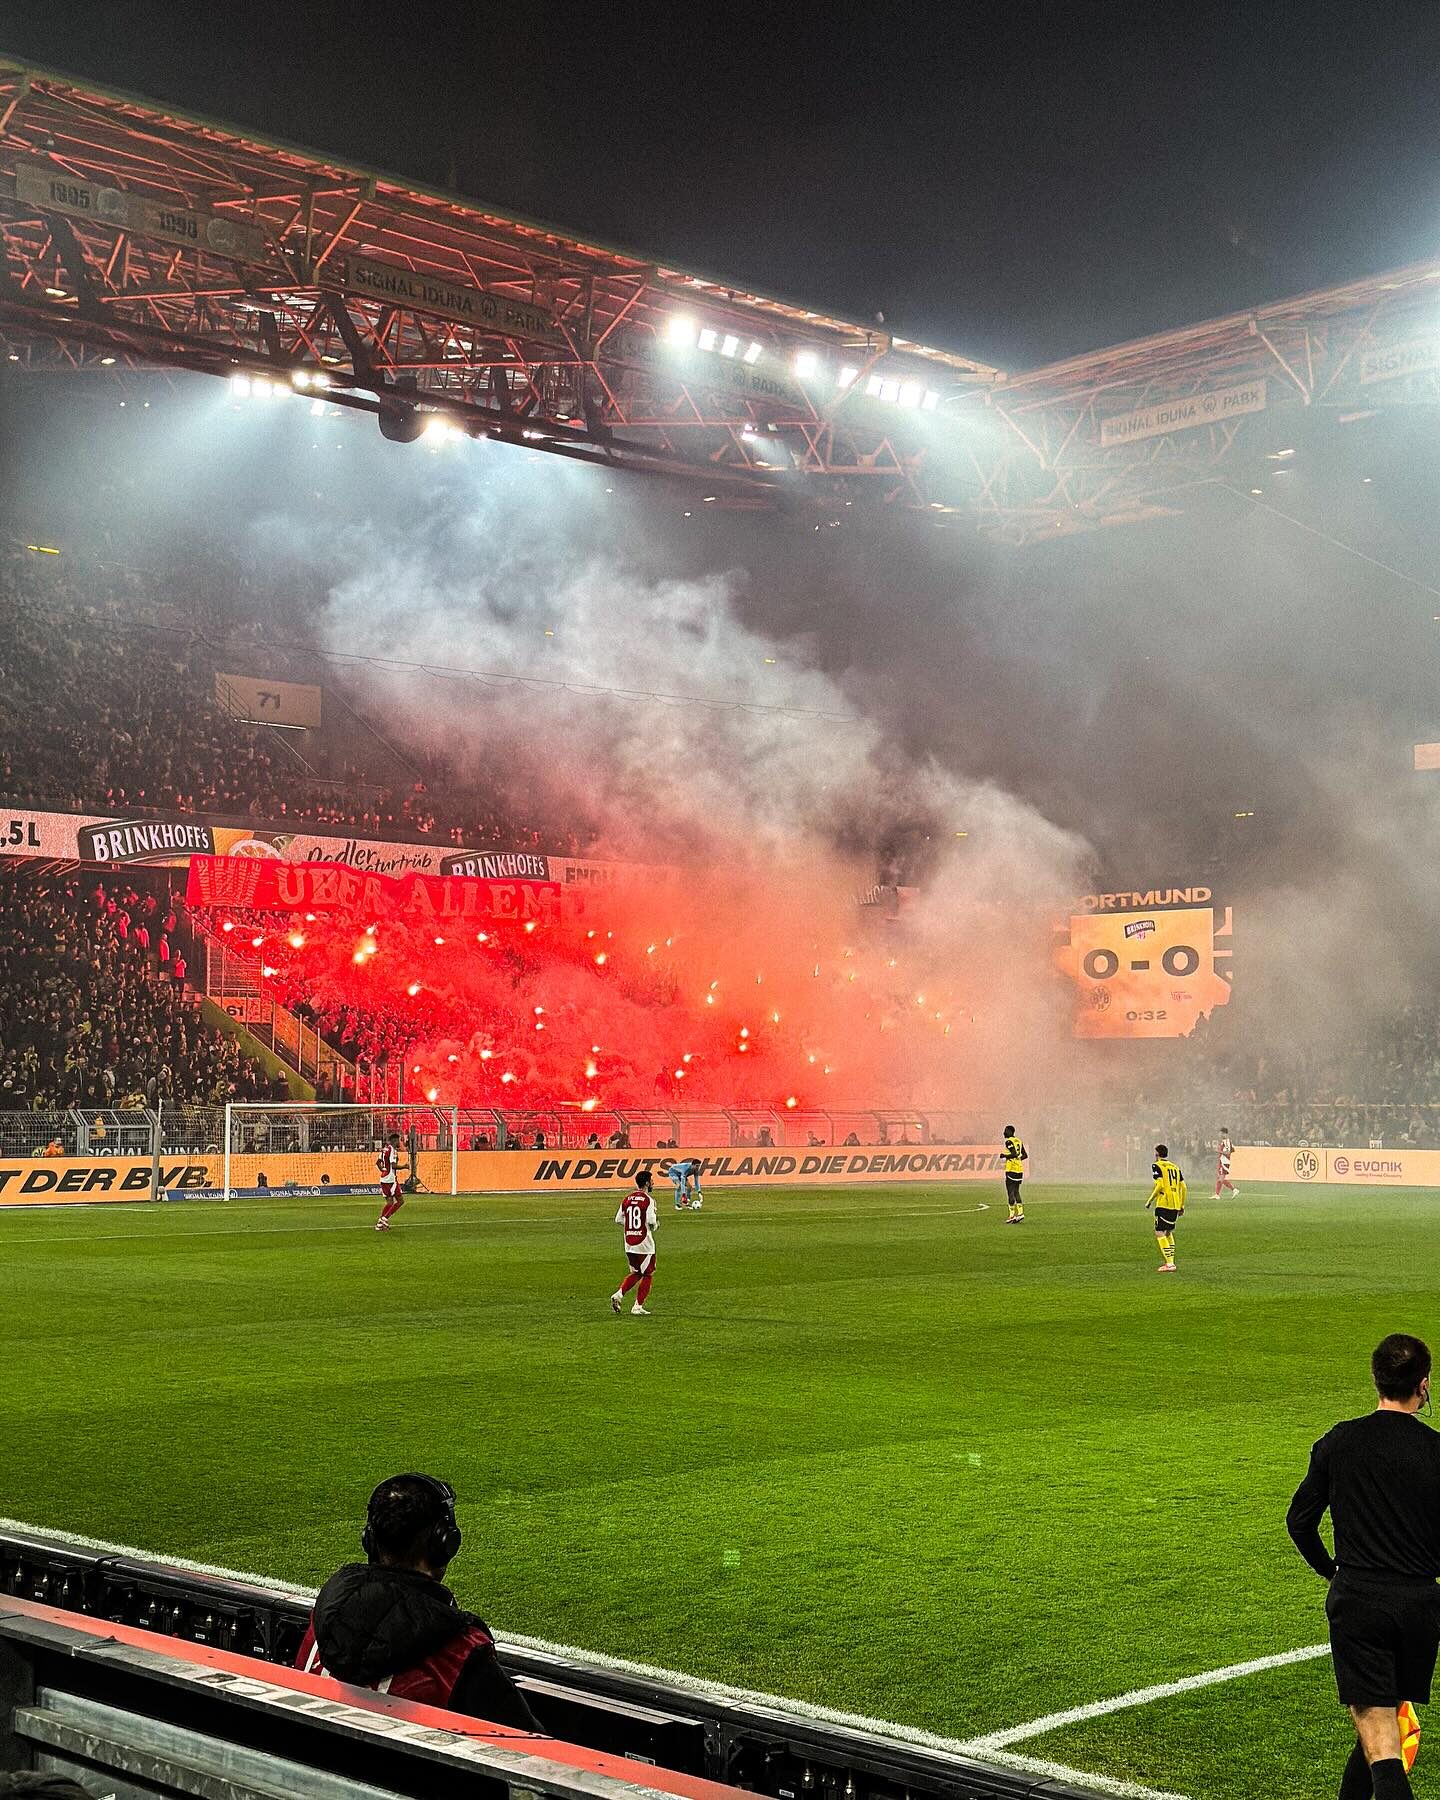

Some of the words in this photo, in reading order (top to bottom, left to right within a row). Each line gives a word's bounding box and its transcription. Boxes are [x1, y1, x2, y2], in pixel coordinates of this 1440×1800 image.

[356, 269, 417, 298] SIGNAL
[422, 284, 473, 313] IDUNA
[1157, 406, 1196, 425] IDUNA
[1223, 391, 1258, 410] PARK
[257, 691, 280, 709] 71
[92, 825, 209, 862] BRINKHOFF's
[452, 854, 545, 879] BRINKHOFF's
[1079, 887, 1212, 909] ORTMUND
[1083, 948, 1119, 979] 0
[1162, 945, 1199, 977] 0
[226, 1005, 244, 1017] 61
[1126, 1010, 1167, 1021] 0:32
[534, 1160, 571, 1181] IN
[799, 1155, 848, 1175] DIE
[1296, 1152, 1316, 1171] BVB
[1354, 1160, 1402, 1172] EVONIK
[19, 1168, 117, 1194] DER
[119, 1166, 213, 1190] BVB.
[1167, 1168, 1178, 1186] 14
[626, 1206, 642, 1229] 18
